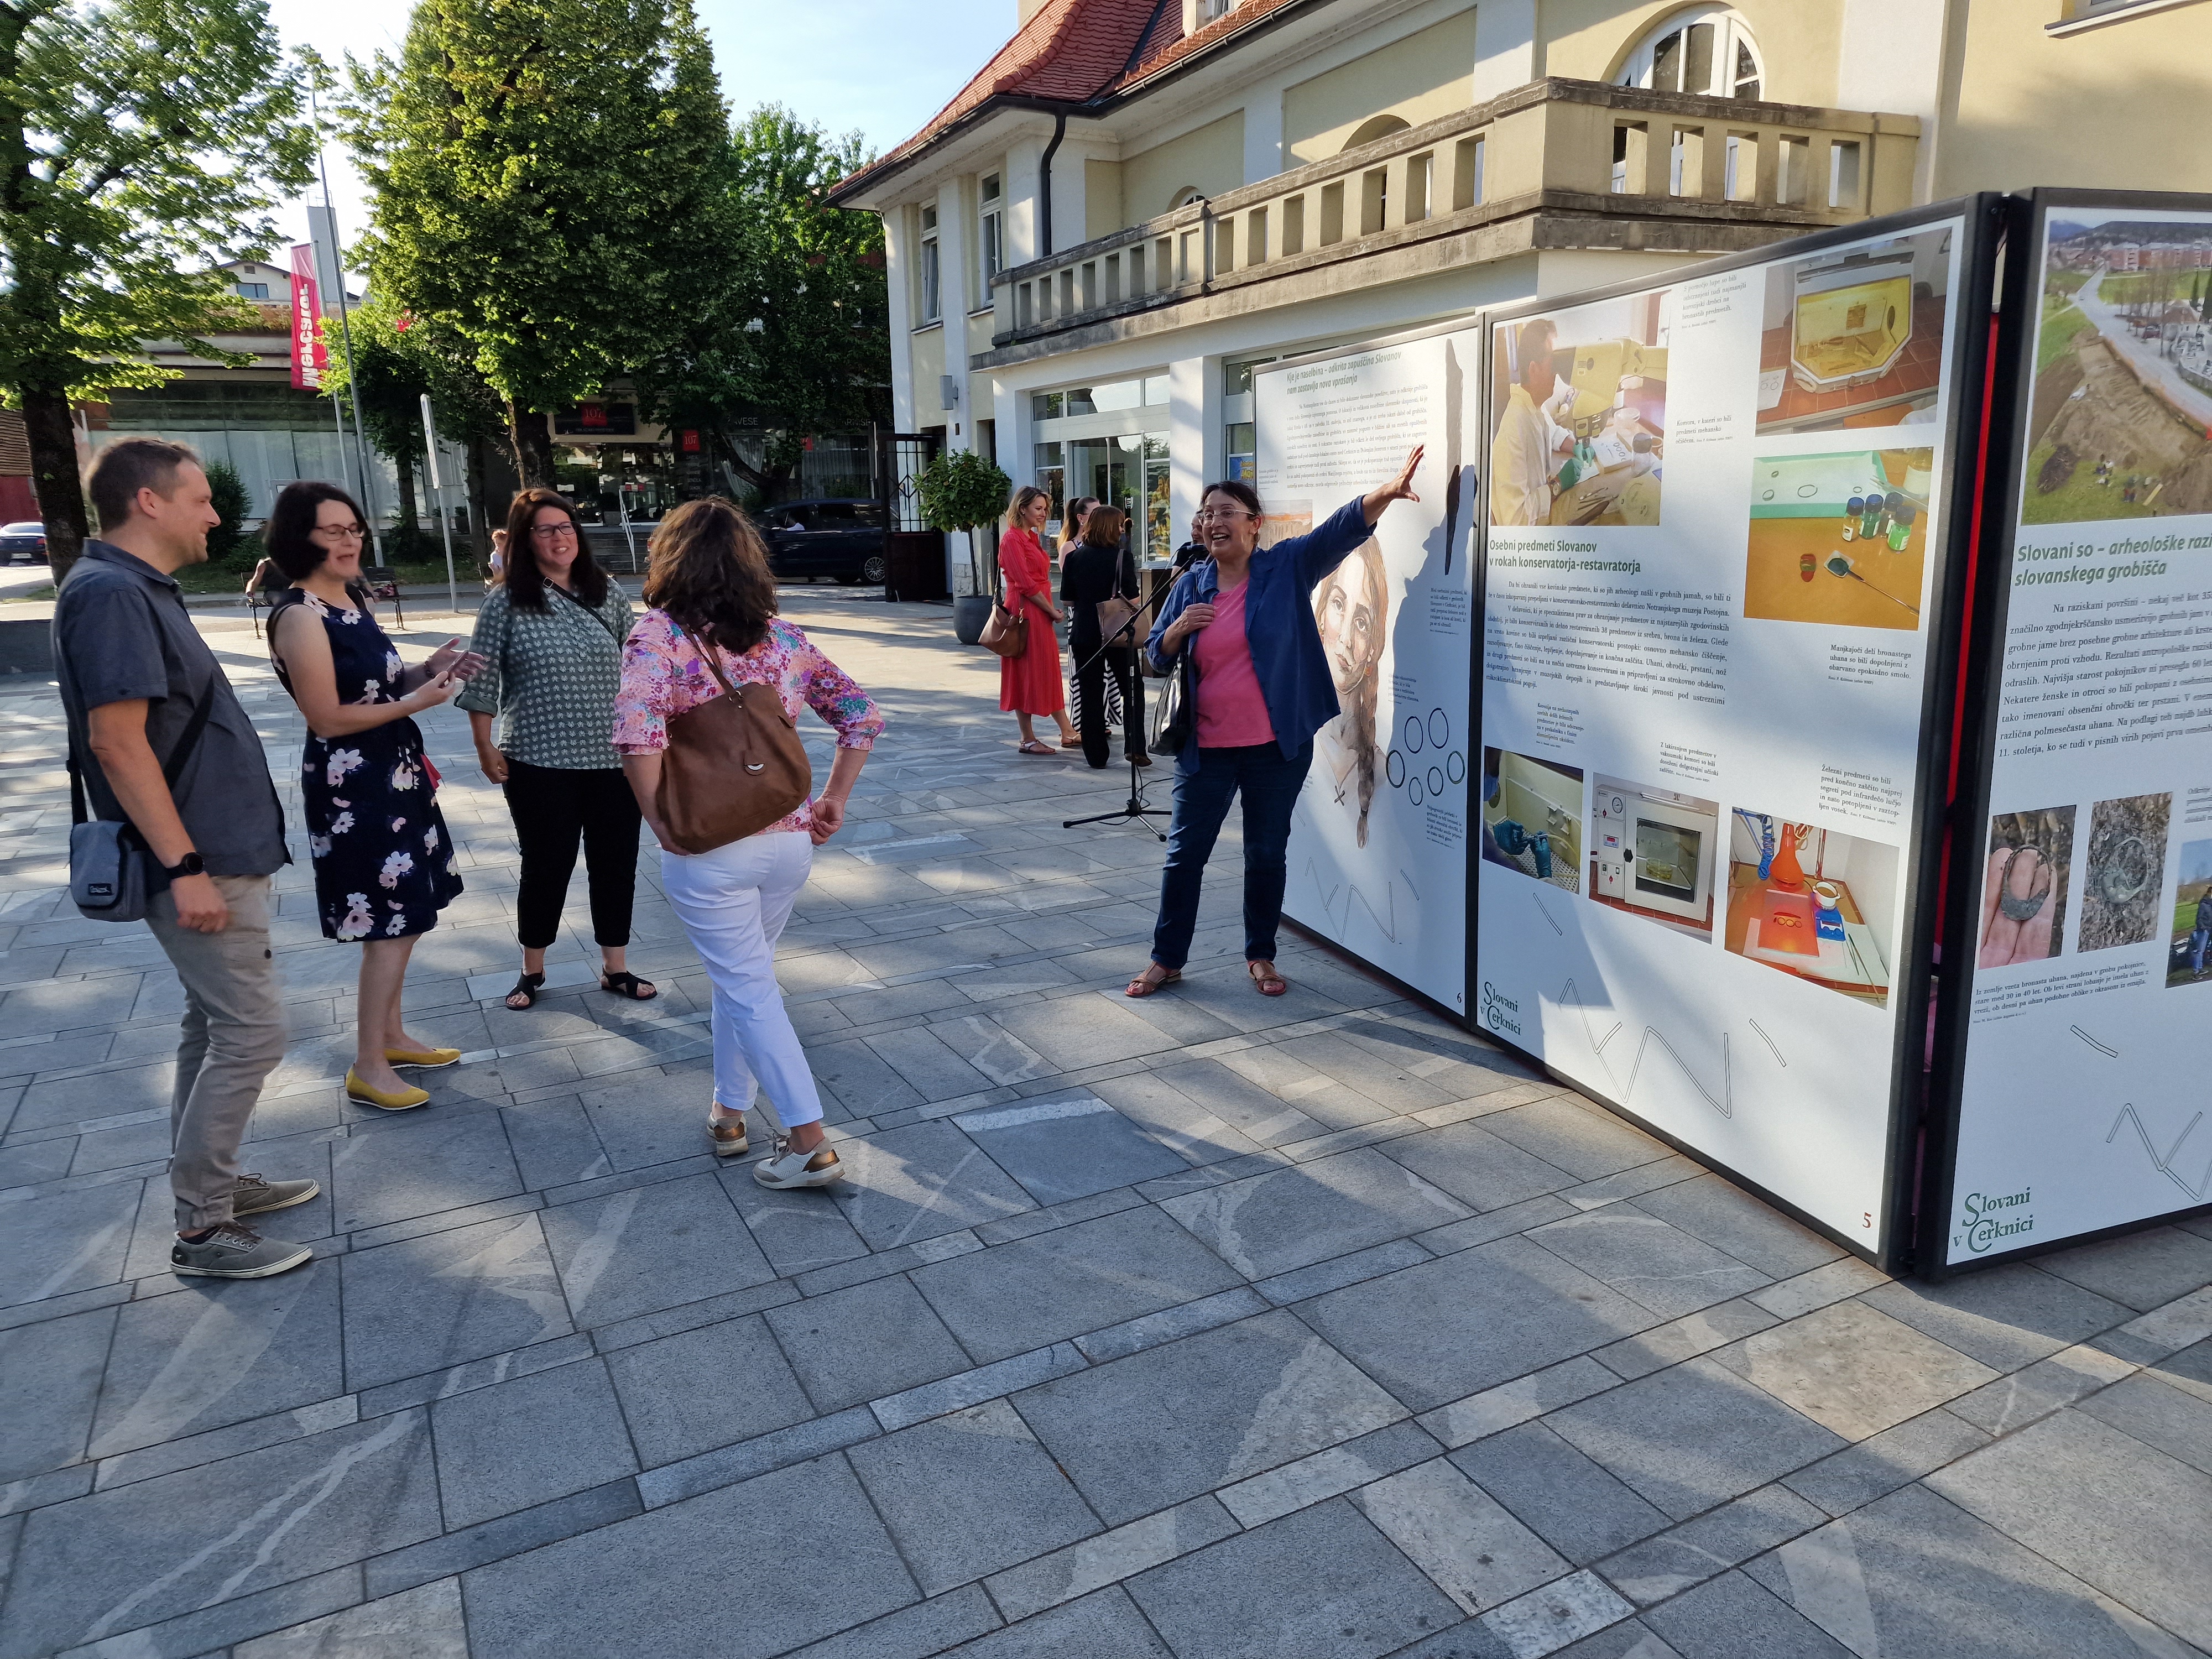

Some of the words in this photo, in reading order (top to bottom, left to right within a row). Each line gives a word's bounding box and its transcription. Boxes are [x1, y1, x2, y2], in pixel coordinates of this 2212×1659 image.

[1295, 372, 1300, 383] je
[1300, 367, 1324, 379] naselbina
[1328, 362, 1347, 374] odkrita
[1347, 357, 1374, 372] zapuščina
[1375, 351, 1401, 364] Slovanov
[1297, 380, 1318, 393] zastavlja
[1319, 379, 1331, 389] nova
[1332, 374, 1358, 388] vprašanja
[684, 435, 697, 445] 107
[1489, 539, 1516, 551] Osebni
[1517, 539, 1555, 554] predmeti
[1557, 540, 1597, 553] Slovanov
[2017, 541, 2074, 562] Slovani
[2076, 544, 2093, 558] so
[2109, 534, 2185, 556] arheološke
[1489, 557, 1493, 566] v
[1495, 555, 1517, 567] rokah
[1519, 556, 1641, 576] konservatorja-restavratorja
[2015, 565, 2104, 587] slovanskega
[2108, 559, 2166, 583] grobišča
[1659, 590, 1682, 599] grobnih
[1683, 591, 1703, 601] jamah,
[1713, 592, 1724, 601] bili
[1726, 593, 1731, 602] ti
[1682, 606, 1702, 617] muzeja
[1703, 607, 1729, 618] Postojna.
[2053, 604, 2064, 613] Na
[2067, 601, 2103, 612] raziskani
[1656, 618, 1688, 629] najstarejših
[1690, 621, 1729, 632] zgodovinskih
[2010, 624, 2043, 634] značilno
[2046, 617, 2112, 634] zgodnjekrščansko
[1663, 632, 1681, 641] brona
[1681, 633, 1688, 642] in
[1689, 635, 1709, 644] železa.
[1710, 637, 1729, 646] Glede
[2008, 642, 2036, 655] grobne
[2038, 641, 2057, 653] jame
[2059, 639, 2076, 648] brez
[2078, 635, 2110, 649] posebne
[2111, 633, 2138, 645] grobne
[1616, 643, 1641, 652] postopki:
[1669, 648, 1698, 658] mehansko
[1701, 651, 1727, 663] čiščenje,
[1829, 654, 1848, 662] uhana
[1869, 658, 1902, 669] dopolnjeni
[1830, 644, 1863, 655] Manjkajoči
[1877, 648, 1911, 660] bronastega
[2006, 660, 2048, 671] obrnjenim
[2051, 655, 2070, 669] proti
[2072, 653, 2102, 664] vzhodu.
[1646, 658, 1664, 669] Uhani,
[1666, 661, 1689, 672] obročki,
[1690, 666, 1714, 676] prstani,
[1829, 664, 1856, 672] obarvano
[1857, 667, 1888, 676] epoksidno
[2005, 676, 2039, 688] odraslih.
[2043, 673, 2074, 686] Najvišja
[2076, 671, 2102, 680] starost
[2104, 666, 2147, 680] pokojnikov
[1626, 670, 1658, 682] pripravljeni
[1667, 676, 1695, 686] strokovno
[1697, 680, 1725, 692] obdelavo,
[1633, 684, 1648, 693] široki
[1652, 686, 1673, 697] javnosti
[1677, 692, 1689, 700] pod
[1693, 695, 1725, 705] ustreznimi
[2004, 695, 2039, 705] Nekatere
[2042, 691, 2068, 701] ženske
[2082, 688, 2105, 697] otroci
[2119, 683, 2132, 693] bili
[2135, 679, 2171, 694] pokopani
[2002, 713, 2019, 723] tako
[2023, 707, 2064, 721] imenovani
[2068, 704, 2103, 715] obsenčni
[2106, 700, 2135, 711] obročki
[2000, 729, 2031, 740] različna
[2034, 724, 2086, 739] polmesečasta
[2088, 721, 2114, 730] uhana.
[2117, 717, 2128, 726] Na
[2130, 714, 2158, 728] podlagi
[2000, 748, 2010, 757] 11.
[2012, 744, 2044, 756] stoletja,
[2047, 743, 2056, 752] ko
[2069, 738, 2085, 749] tudi
[2094, 735, 2119, 748] pisnih
[1821, 764, 1842, 775] Železni
[1843, 771, 1870, 781] predmeti
[1880, 776, 1891, 785] bili
[1820, 785, 1839, 794] segreti
[1853, 790, 1884, 803] infrardečo
[1885, 797, 1901, 808] lučjo
[1835, 777, 1856, 787] končno
[1858, 783, 1879, 792] zaščito
[1880, 787, 1902, 798] najprej
[1841, 800, 1871, 810] potopljeni
[1878, 807, 1900, 817] raztop-
[1457, 992, 1462, 1003] 6
[1484, 981, 1518, 1013] Slovani
[1983, 985, 2003, 994] zemlje
[1480, 1005, 1485, 1015] v
[1487, 1005, 1521, 1035] Cerknici
[1961, 1187, 2031, 1227] Slovani
[1862, 1212, 1872, 1228] 5
[1953, 1235, 1963, 1247] v
[1967, 1214, 2034, 1253] Cerknici
